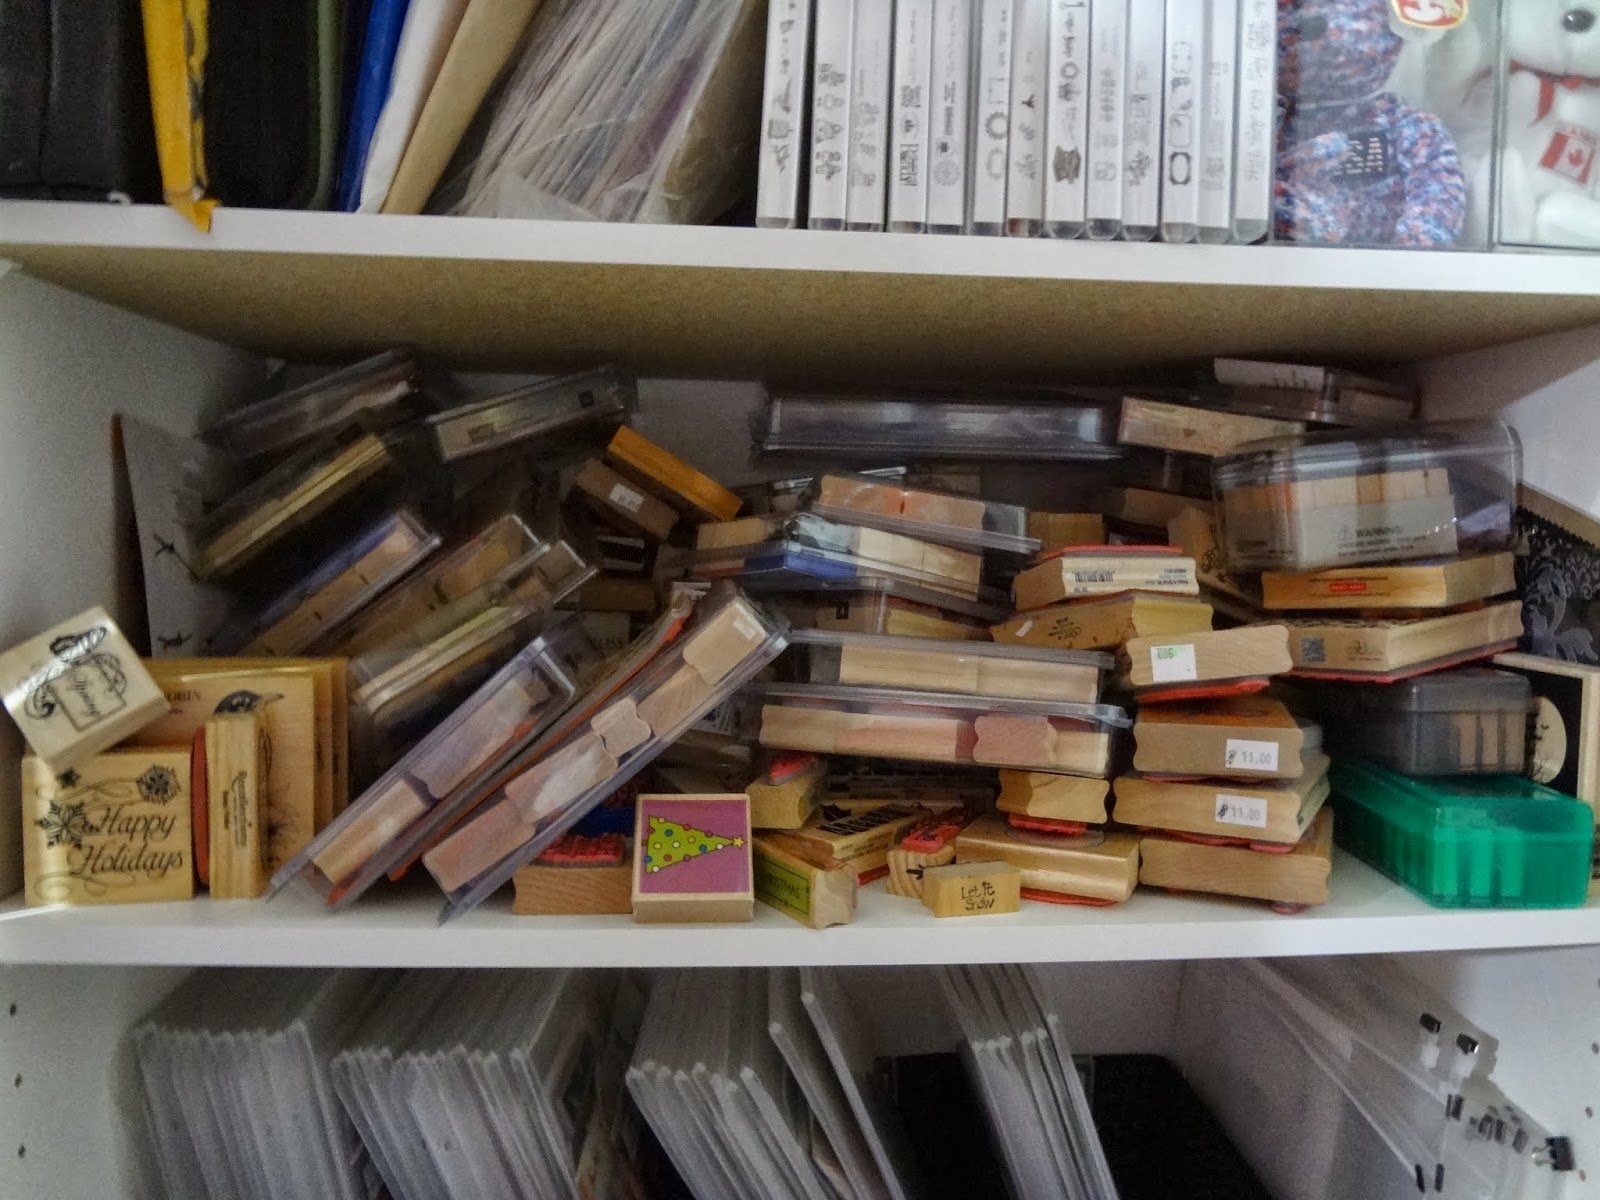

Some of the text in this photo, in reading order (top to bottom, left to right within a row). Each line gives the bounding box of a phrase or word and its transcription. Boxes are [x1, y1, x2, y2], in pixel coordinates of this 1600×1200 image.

[98, 802, 176, 842] Happy
[79, 842, 183, 878] Holidays
[960, 885, 981, 899] Let
